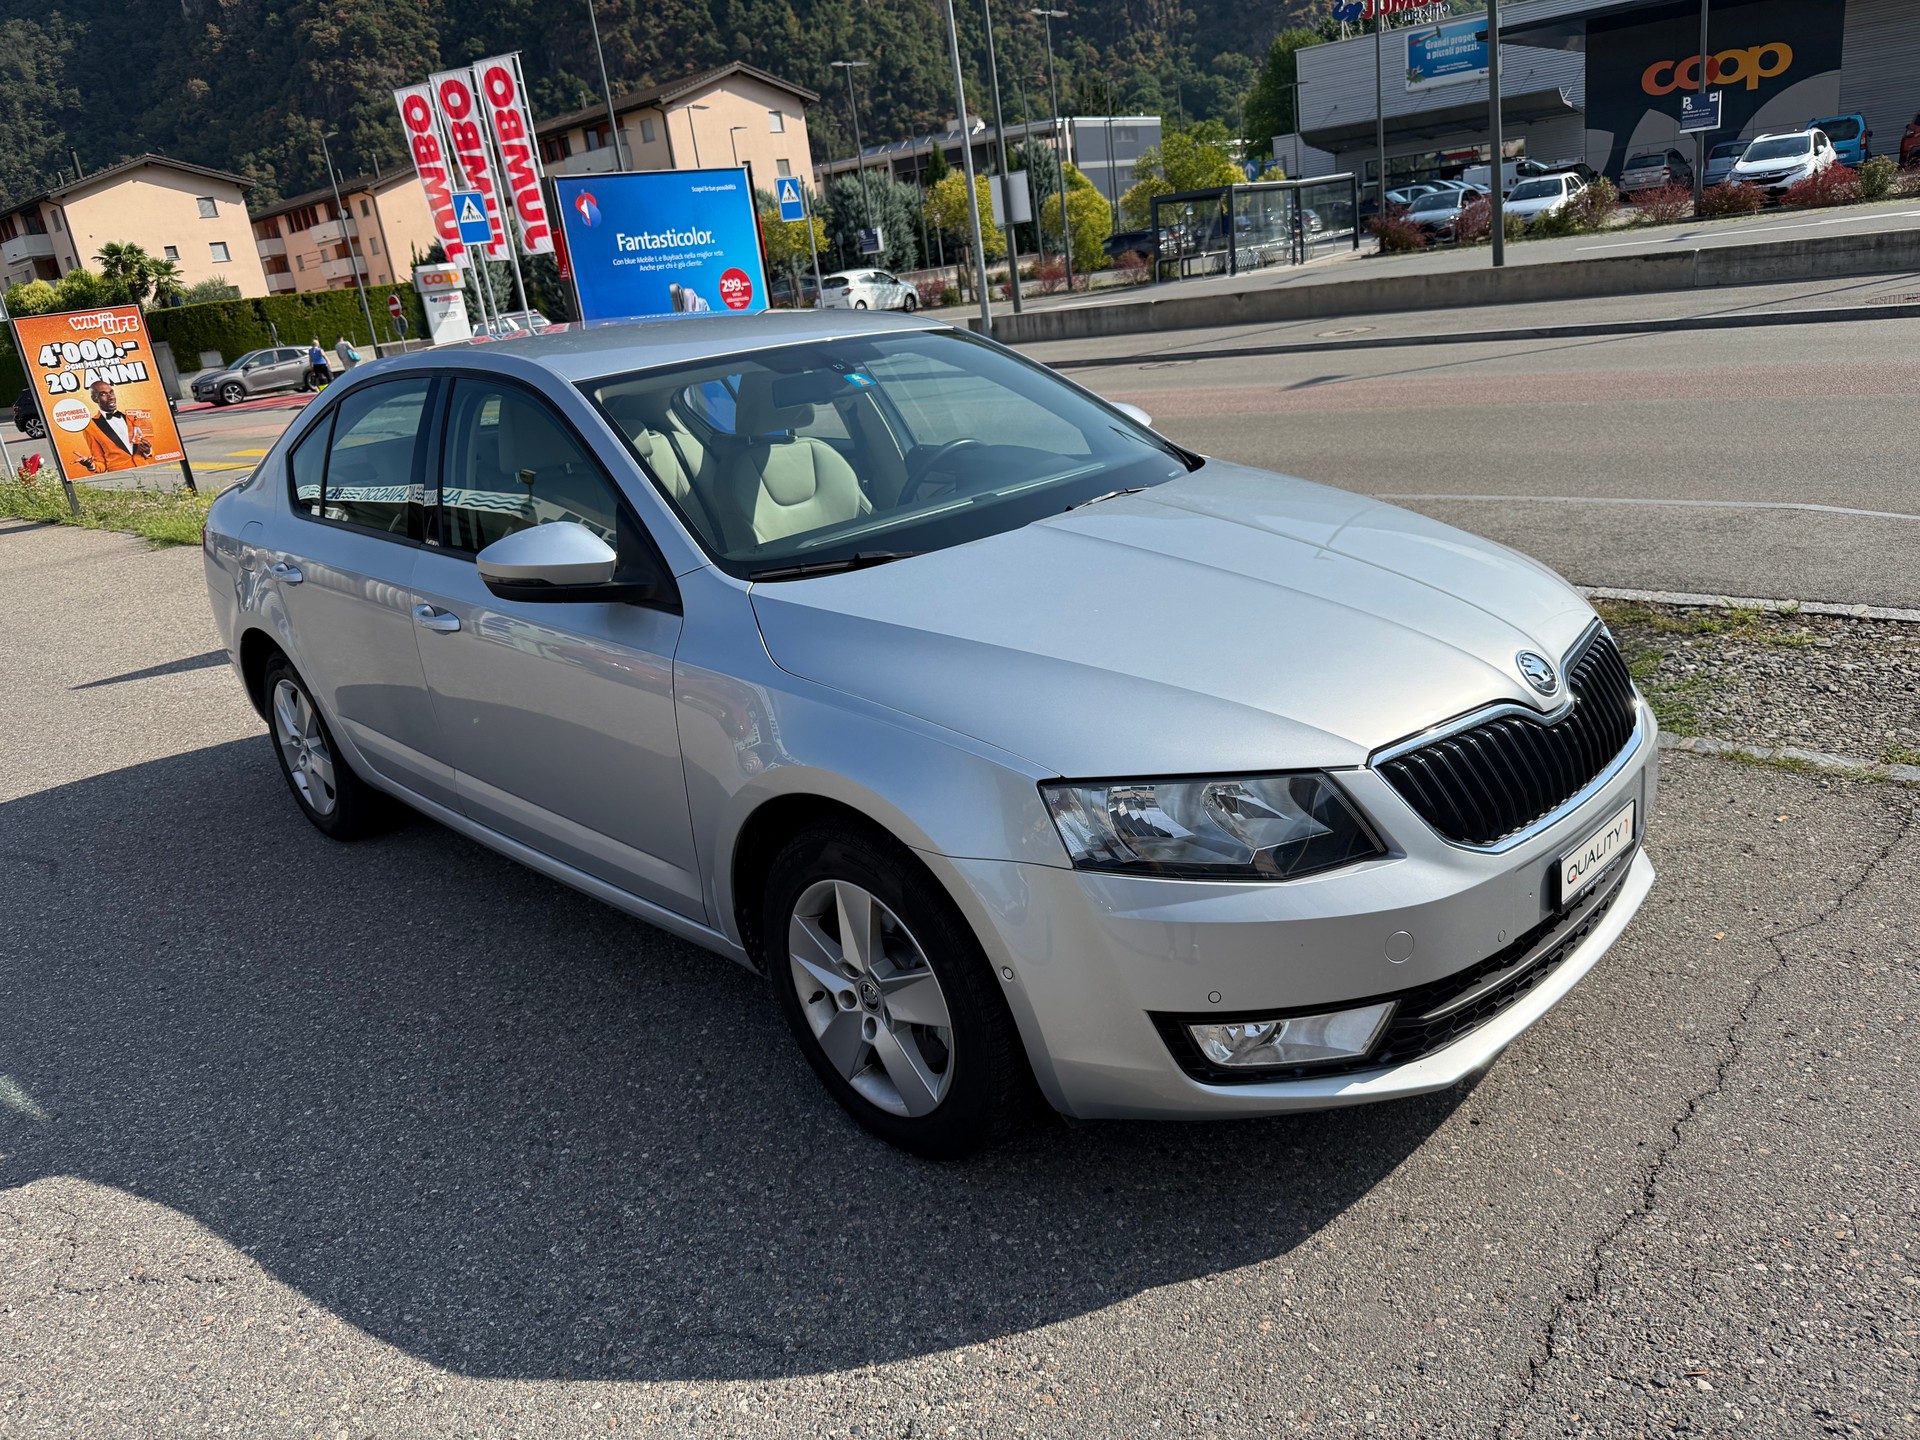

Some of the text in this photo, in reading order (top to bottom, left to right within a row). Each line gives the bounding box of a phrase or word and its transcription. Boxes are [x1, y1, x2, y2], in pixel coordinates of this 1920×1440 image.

[1362, 0, 1445, 19] JUM
[1425, 31, 1477, 49] Grandi proget
[1432, 46, 1454, 59] piccoli
[1455, 42, 1480, 54] prezzi.
[1641, 42, 1793, 95] coop
[484, 66, 548, 250] JUMBO
[403, 95, 465, 263] JUMBO
[616, 226, 716, 252] Fantasticolor.
[624, 257, 636, 265] blue
[637, 256, 654, 264] Mobile
[663, 253, 683, 262] Buyback
[697, 251, 713, 260] miglior
[678, 261, 686, 269] già
[423, 272, 459, 285] coop
[71, 316, 100, 330] WIN
[102, 316, 139, 334] LIFE
[64, 362, 84, 371] OGNI
[45, 362, 149, 394] 20 ANNI
[55, 407, 87, 417] DISPONIBILE
[1567, 822, 1622, 884] QUALITY
